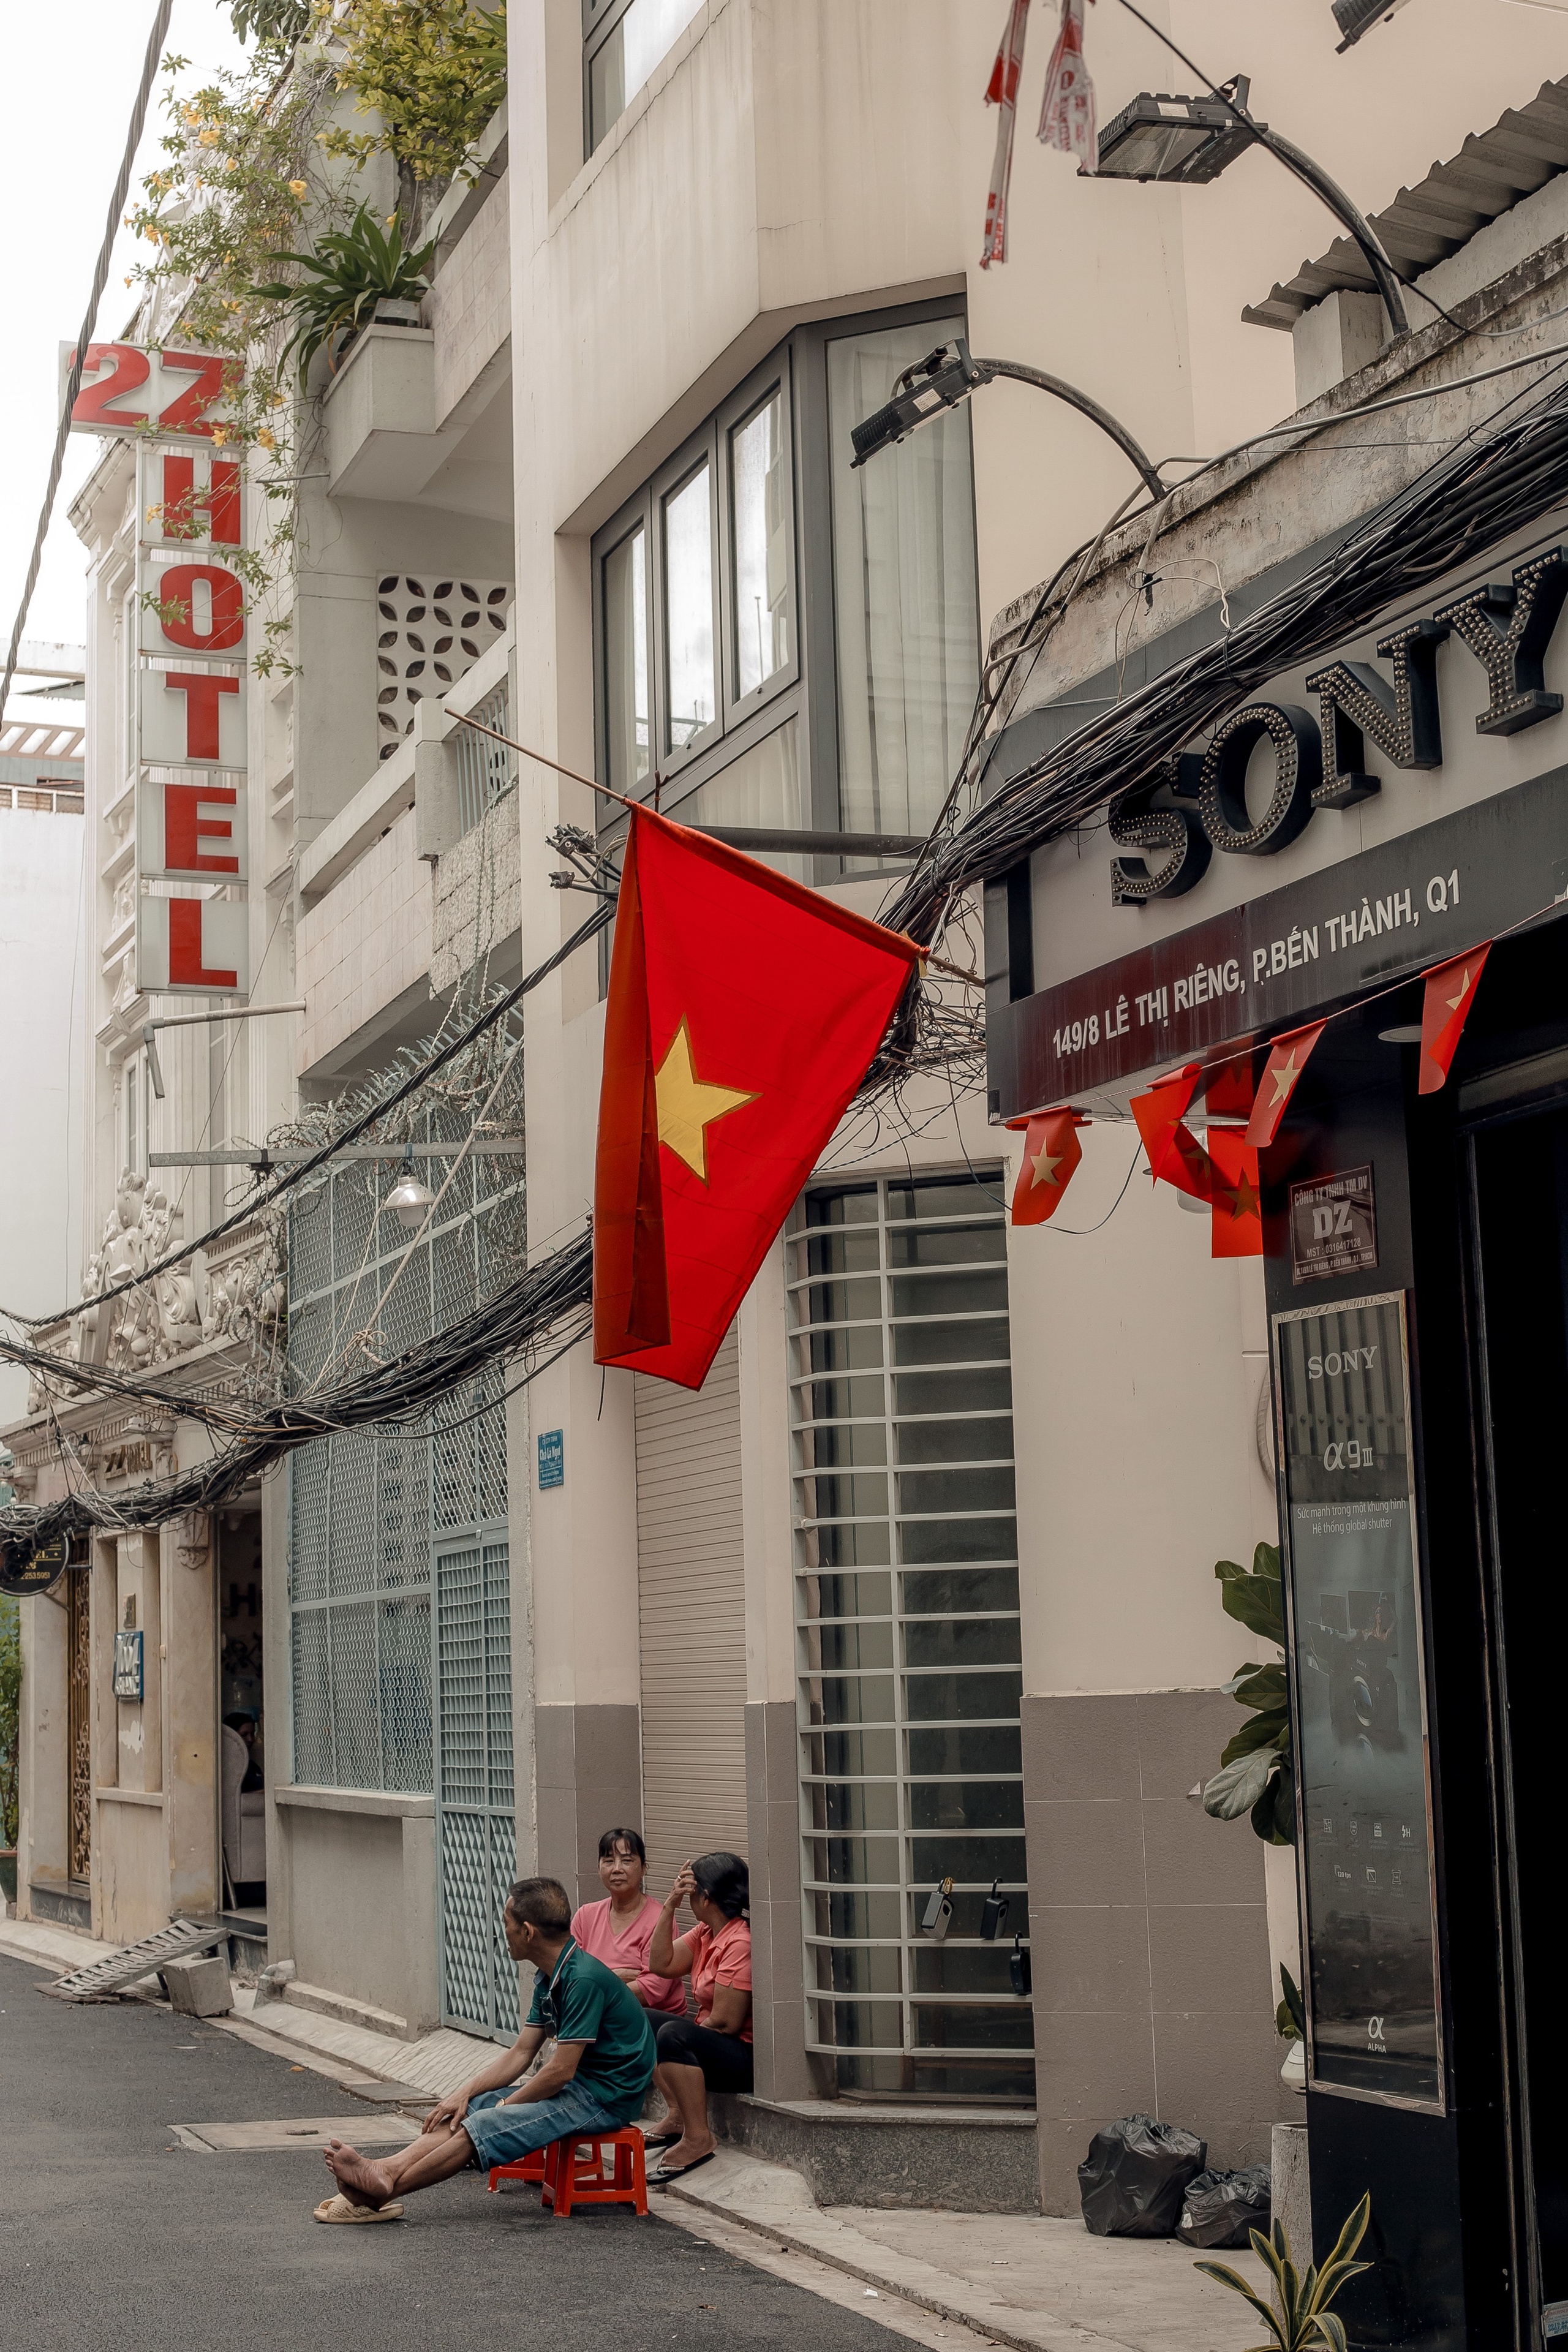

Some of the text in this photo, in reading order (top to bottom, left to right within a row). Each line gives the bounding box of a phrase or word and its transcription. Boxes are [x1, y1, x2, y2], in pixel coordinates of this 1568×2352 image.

[159, 454, 245, 988] HOTEL
[1107, 545, 1568, 907] SONY
[1053, 869, 1460, 1058] 149/8 LÊ THỊ RIÊNG, P.BẾN THÀNH, Q1
[1294, 1175, 1368, 1207] CÔNG TY TNHH TM DV
[1313, 1200, 1353, 1240] DZ
[1306, 1246, 1321, 1258] MST
[1325, 1237, 1362, 1254] 0316417128
[1308, 1346, 1378, 1379] SONY
[1297, 1497, 1406, 1520] Sức mạnh trong một khung hình
[1312, 1517, 1393, 1536] Hệ thống global shutter
[1356, 1657, 1368, 1668] SONY
[1368, 2042, 1387, 2054] ALPHA
